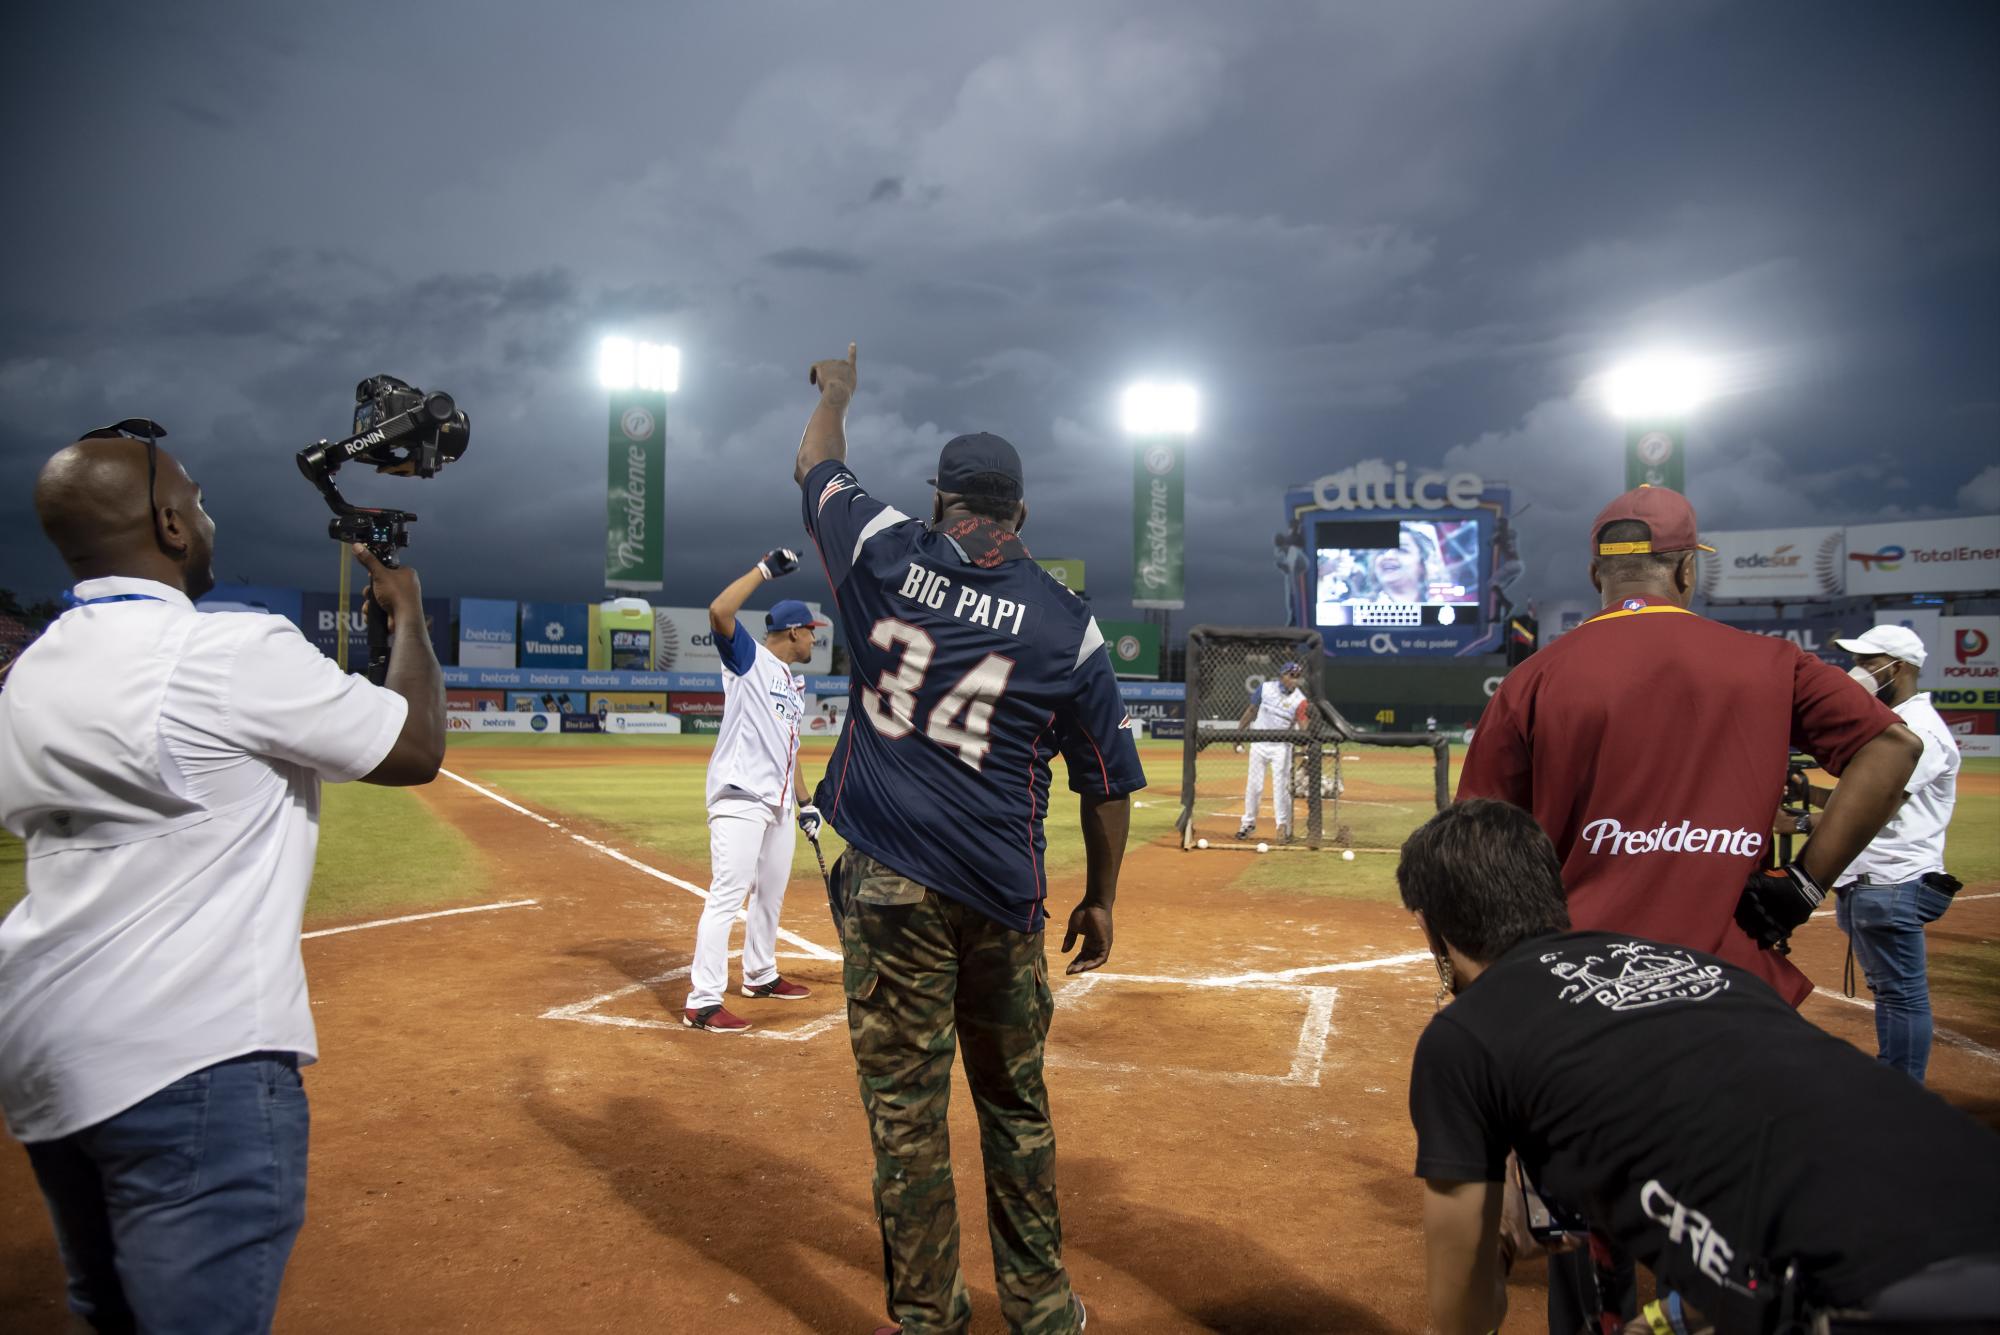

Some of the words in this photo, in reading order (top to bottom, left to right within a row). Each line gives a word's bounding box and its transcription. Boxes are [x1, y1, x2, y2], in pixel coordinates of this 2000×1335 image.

[344, 428, 386, 456] RONIN
[1313, 459, 1484, 511] altice
[618, 445, 647, 569] Presidente
[1143, 479, 1168, 589] Presidente
[1734, 552, 1802, 569] edesur
[898, 562, 951, 610] BIG
[953, 585, 1026, 636] PAPI
[318, 610, 368, 632] BRU
[465, 628, 513, 641] betcris
[525, 641, 583, 655] Vimenca
[1336, 639, 1349, 648] La
[1350, 639, 1367, 648] red
[1401, 639, 1411, 648] te
[1413, 639, 1427, 648] da
[1429, 639, 1458, 650] poder
[443, 671, 469, 682] tcris
[481, 672, 520, 683] betcris
[530, 673, 569, 684] betcris
[582, 675, 619, 685] betcris
[631, 676, 668, 685] betcris
[680, 677, 715, 686] betcris
[1944, 666, 2000, 678] POPULAR
[861, 616, 1016, 774] 34
[1983, 690, 2000, 704] E
[482, 719, 516, 727] betcris
[1375, 709, 1395, 724] 411
[1583, 818, 1762, 857] Presidente
[1640, 1179, 1735, 1287] CRE
